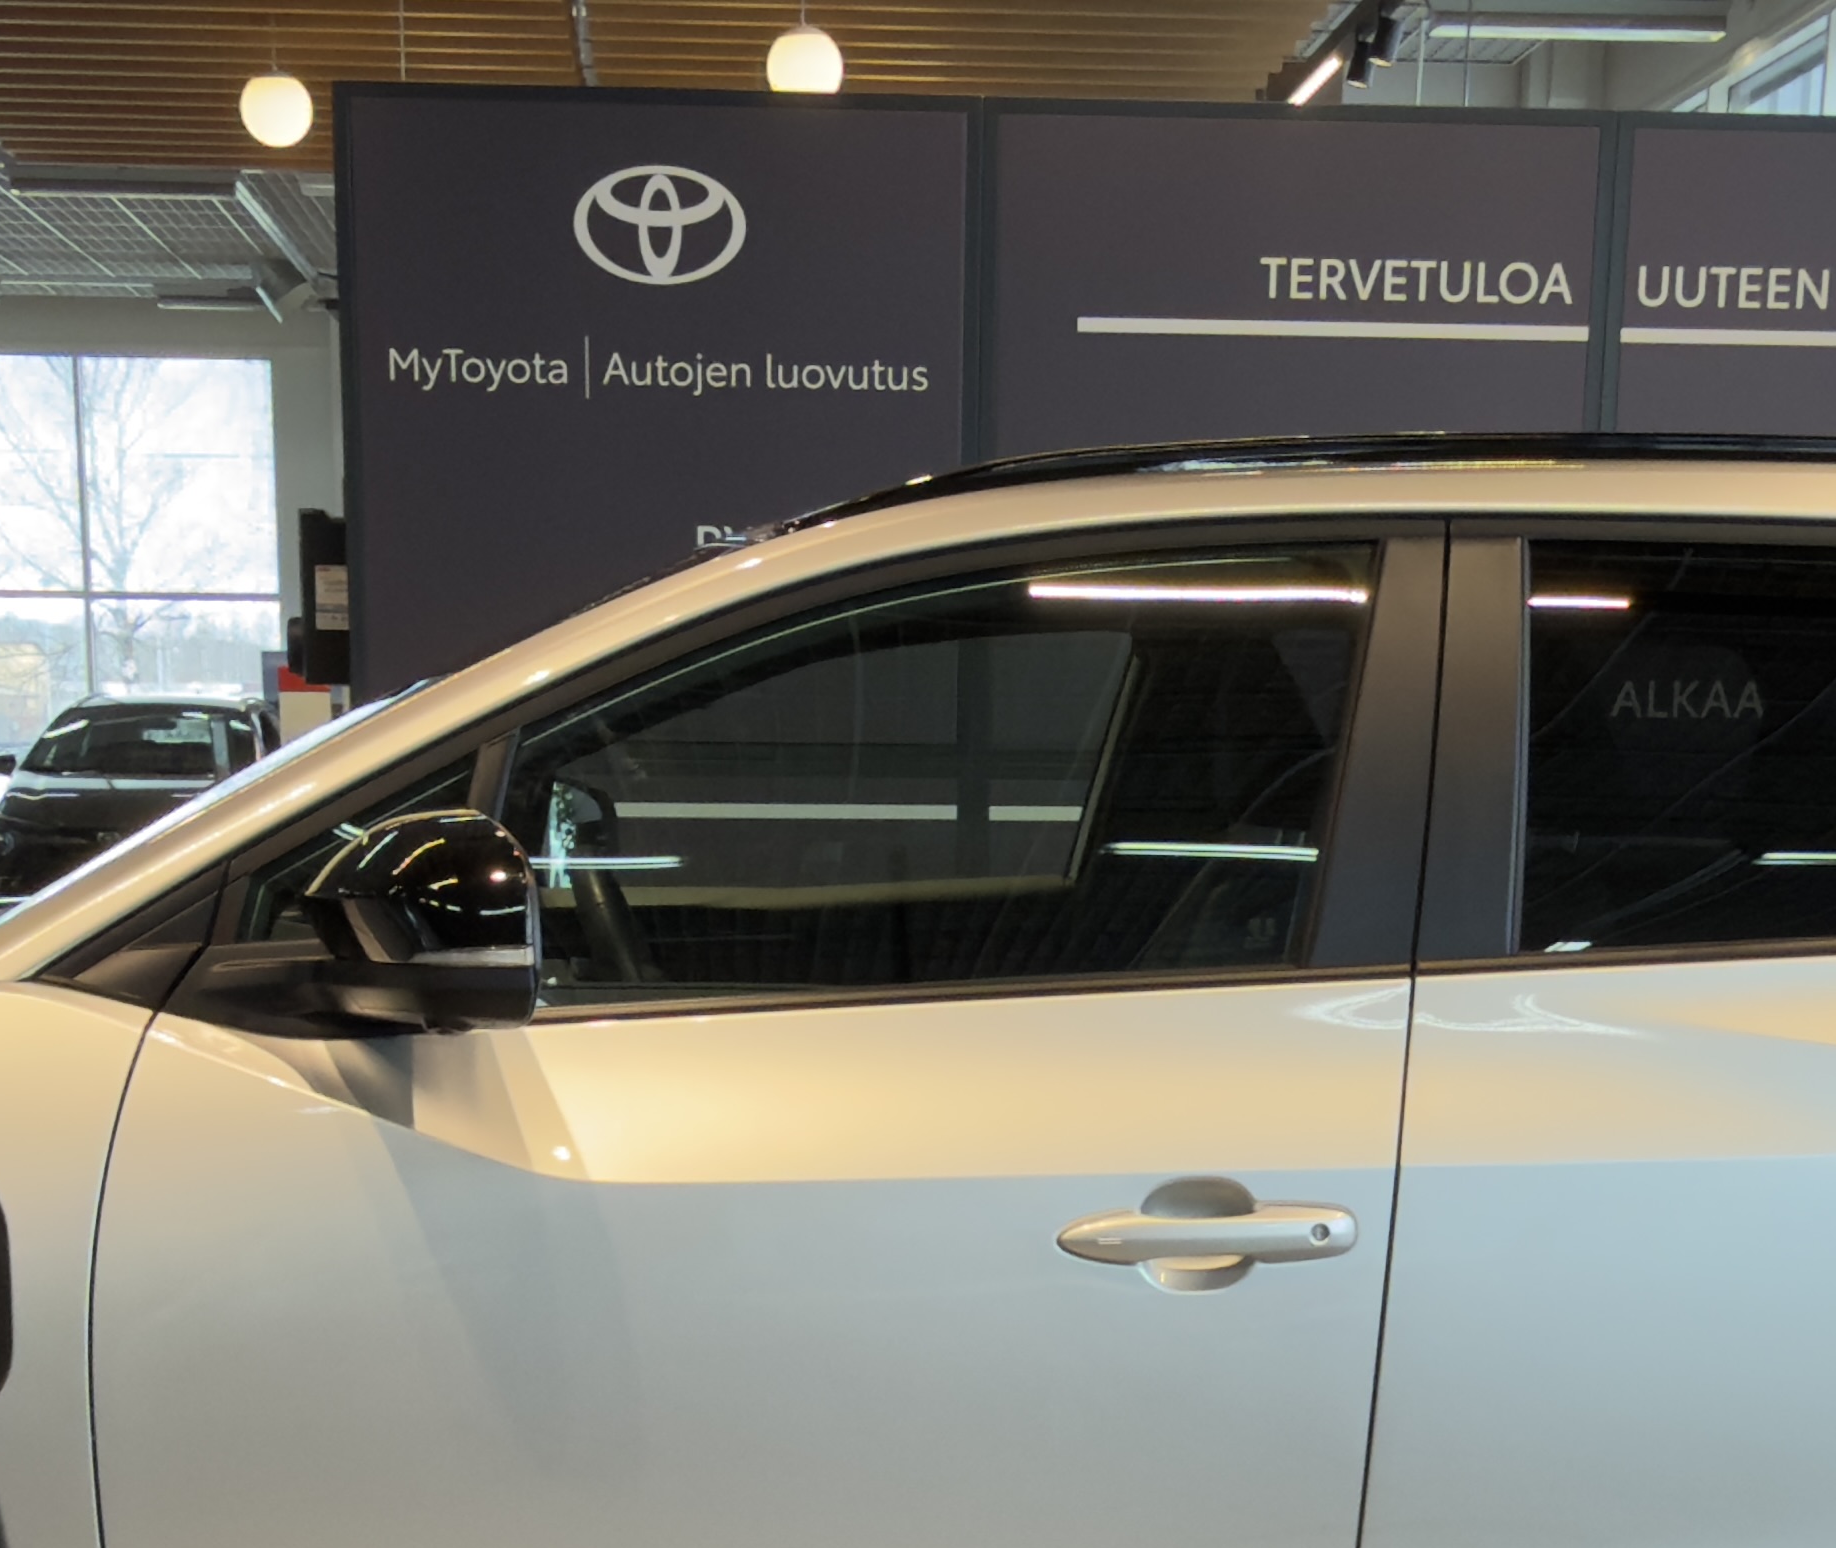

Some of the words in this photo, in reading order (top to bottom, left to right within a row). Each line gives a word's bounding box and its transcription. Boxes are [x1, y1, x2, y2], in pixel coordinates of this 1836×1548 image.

[1260, 256, 1573, 305] TERVETULOA
[1637, 264, 1830, 311] UUTEEN
[388, 347, 568, 392] MyToyota
[602, 351, 752, 396] Autojen
[765, 352, 928, 393] luovutus
[1610, 679, 1764, 719] ALKAA
